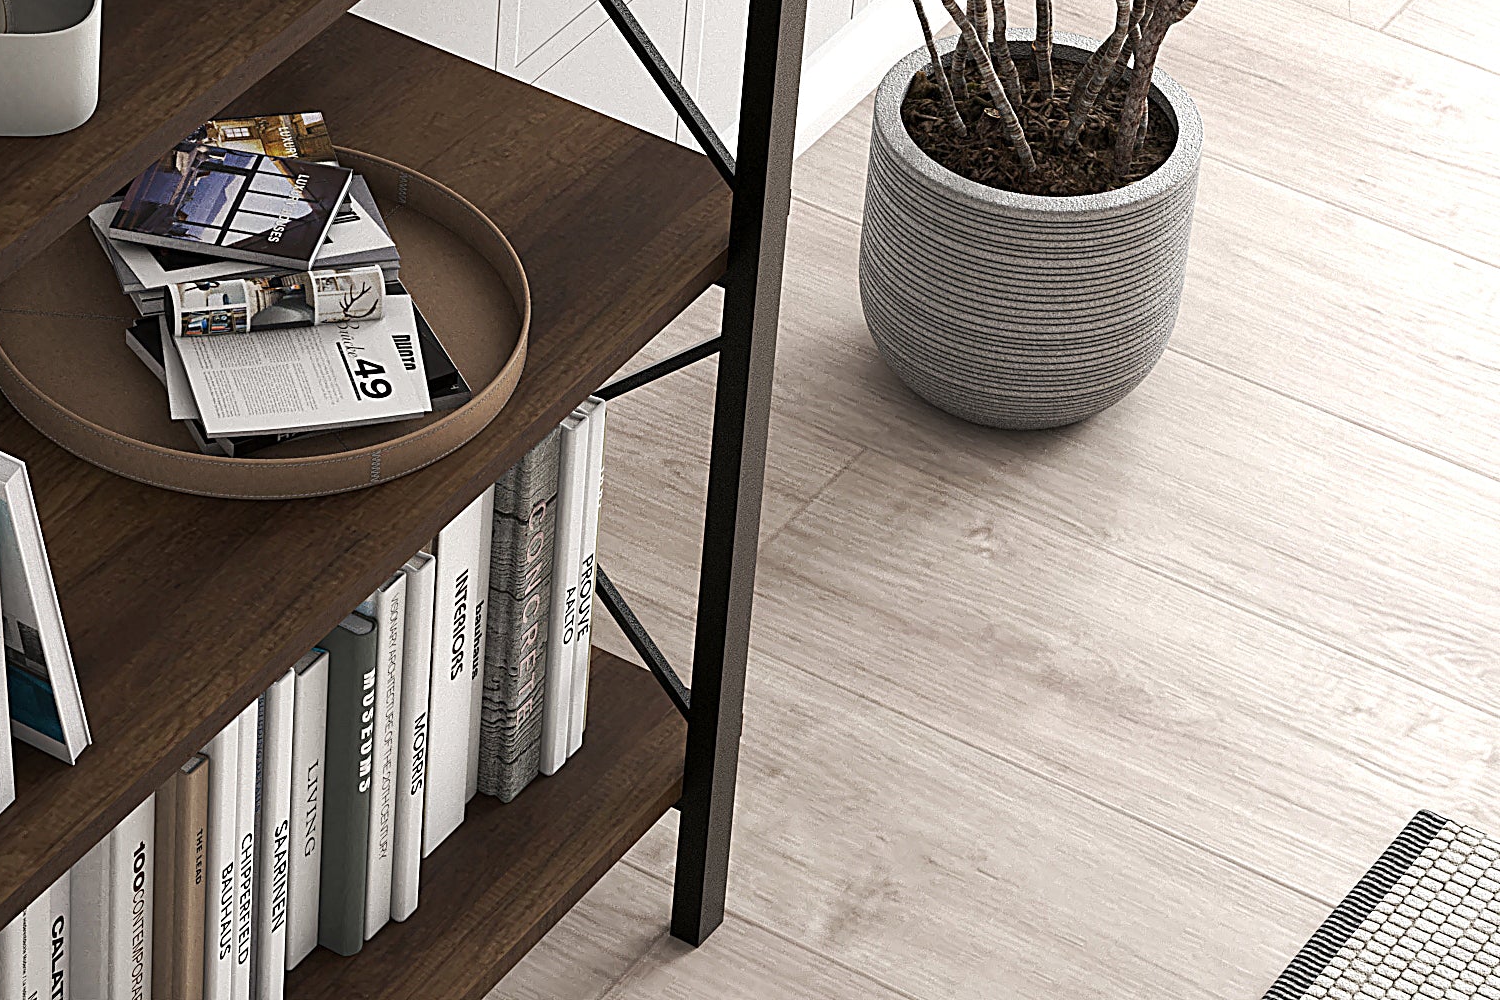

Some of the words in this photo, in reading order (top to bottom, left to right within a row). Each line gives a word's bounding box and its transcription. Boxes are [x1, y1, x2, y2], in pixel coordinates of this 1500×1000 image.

[278, 126, 299, 159] LUXURY
[354, 358, 393, 399] 49
[450, 568, 469, 681] INTERIORS
[516, 500, 547, 728] CONCRETE
[563, 586, 577, 645] AALTO
[359, 668, 376, 794] MUSEUMS
[411, 712, 427, 797] MORRIS
[304, 758, 319, 858] LIVING
[195, 855, 203, 885] LEAD
[219, 862, 234, 961] BAUHAUS
[237, 832, 252, 965] CHIPPERFIELD
[271, 819, 289, 934] SAARINEN
